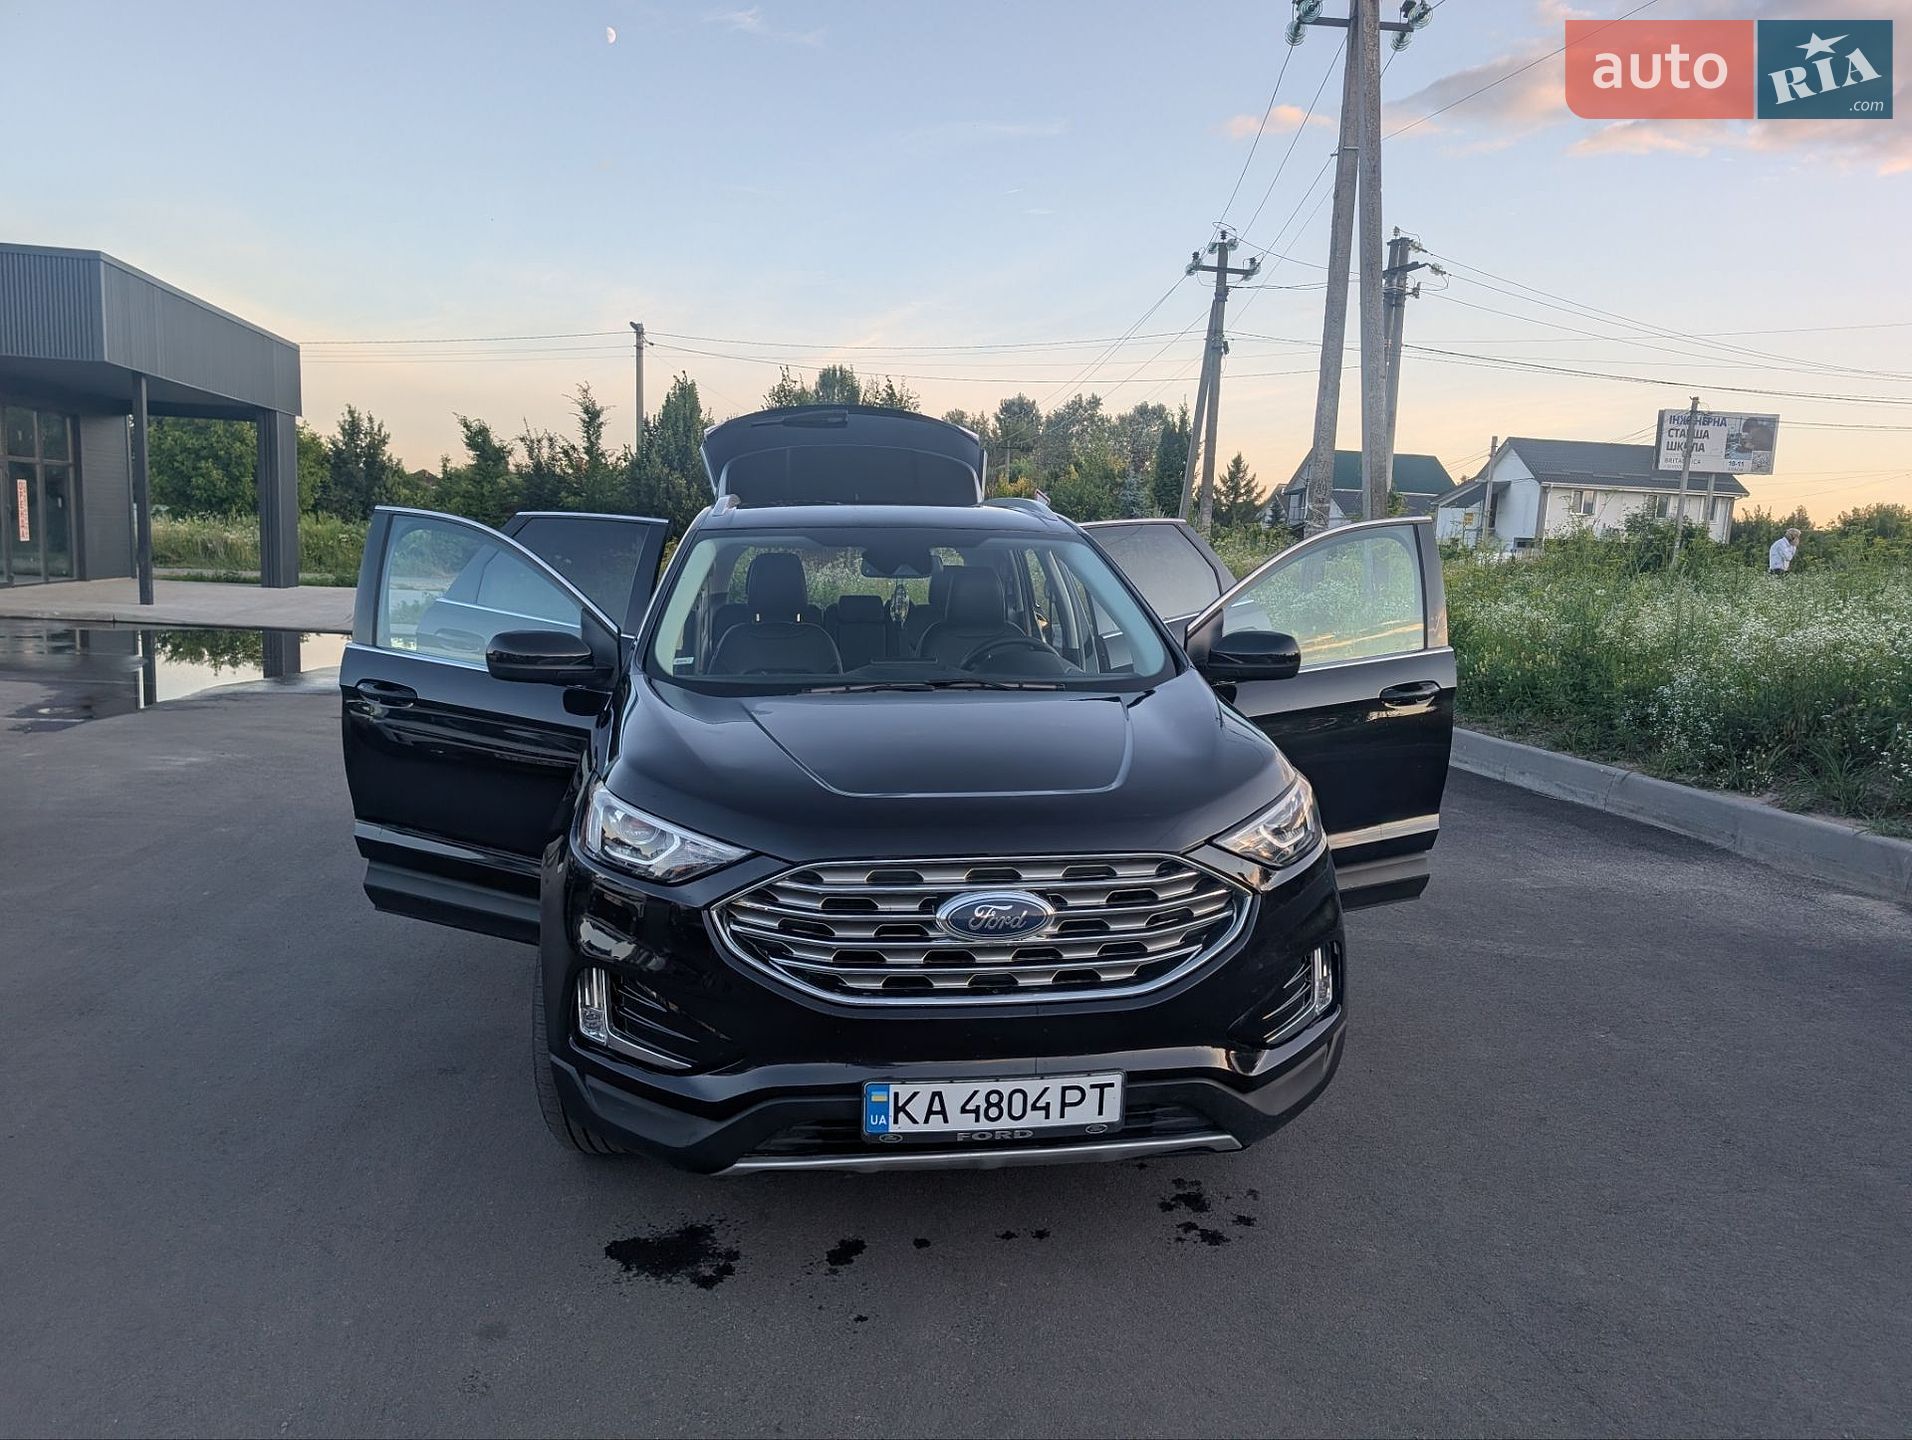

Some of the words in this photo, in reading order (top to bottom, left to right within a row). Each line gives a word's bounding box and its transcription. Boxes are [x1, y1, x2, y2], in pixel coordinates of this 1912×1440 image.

[1667, 428, 1710, 439] СТАША
[968, 904, 1028, 930] Ford
[893, 1090, 949, 1124] KA
[960, 1086, 1050, 1123] 4804
[1059, 1082, 1115, 1119] PT
[870, 1114, 887, 1126] UA
[956, 1129, 1034, 1141] FORD
